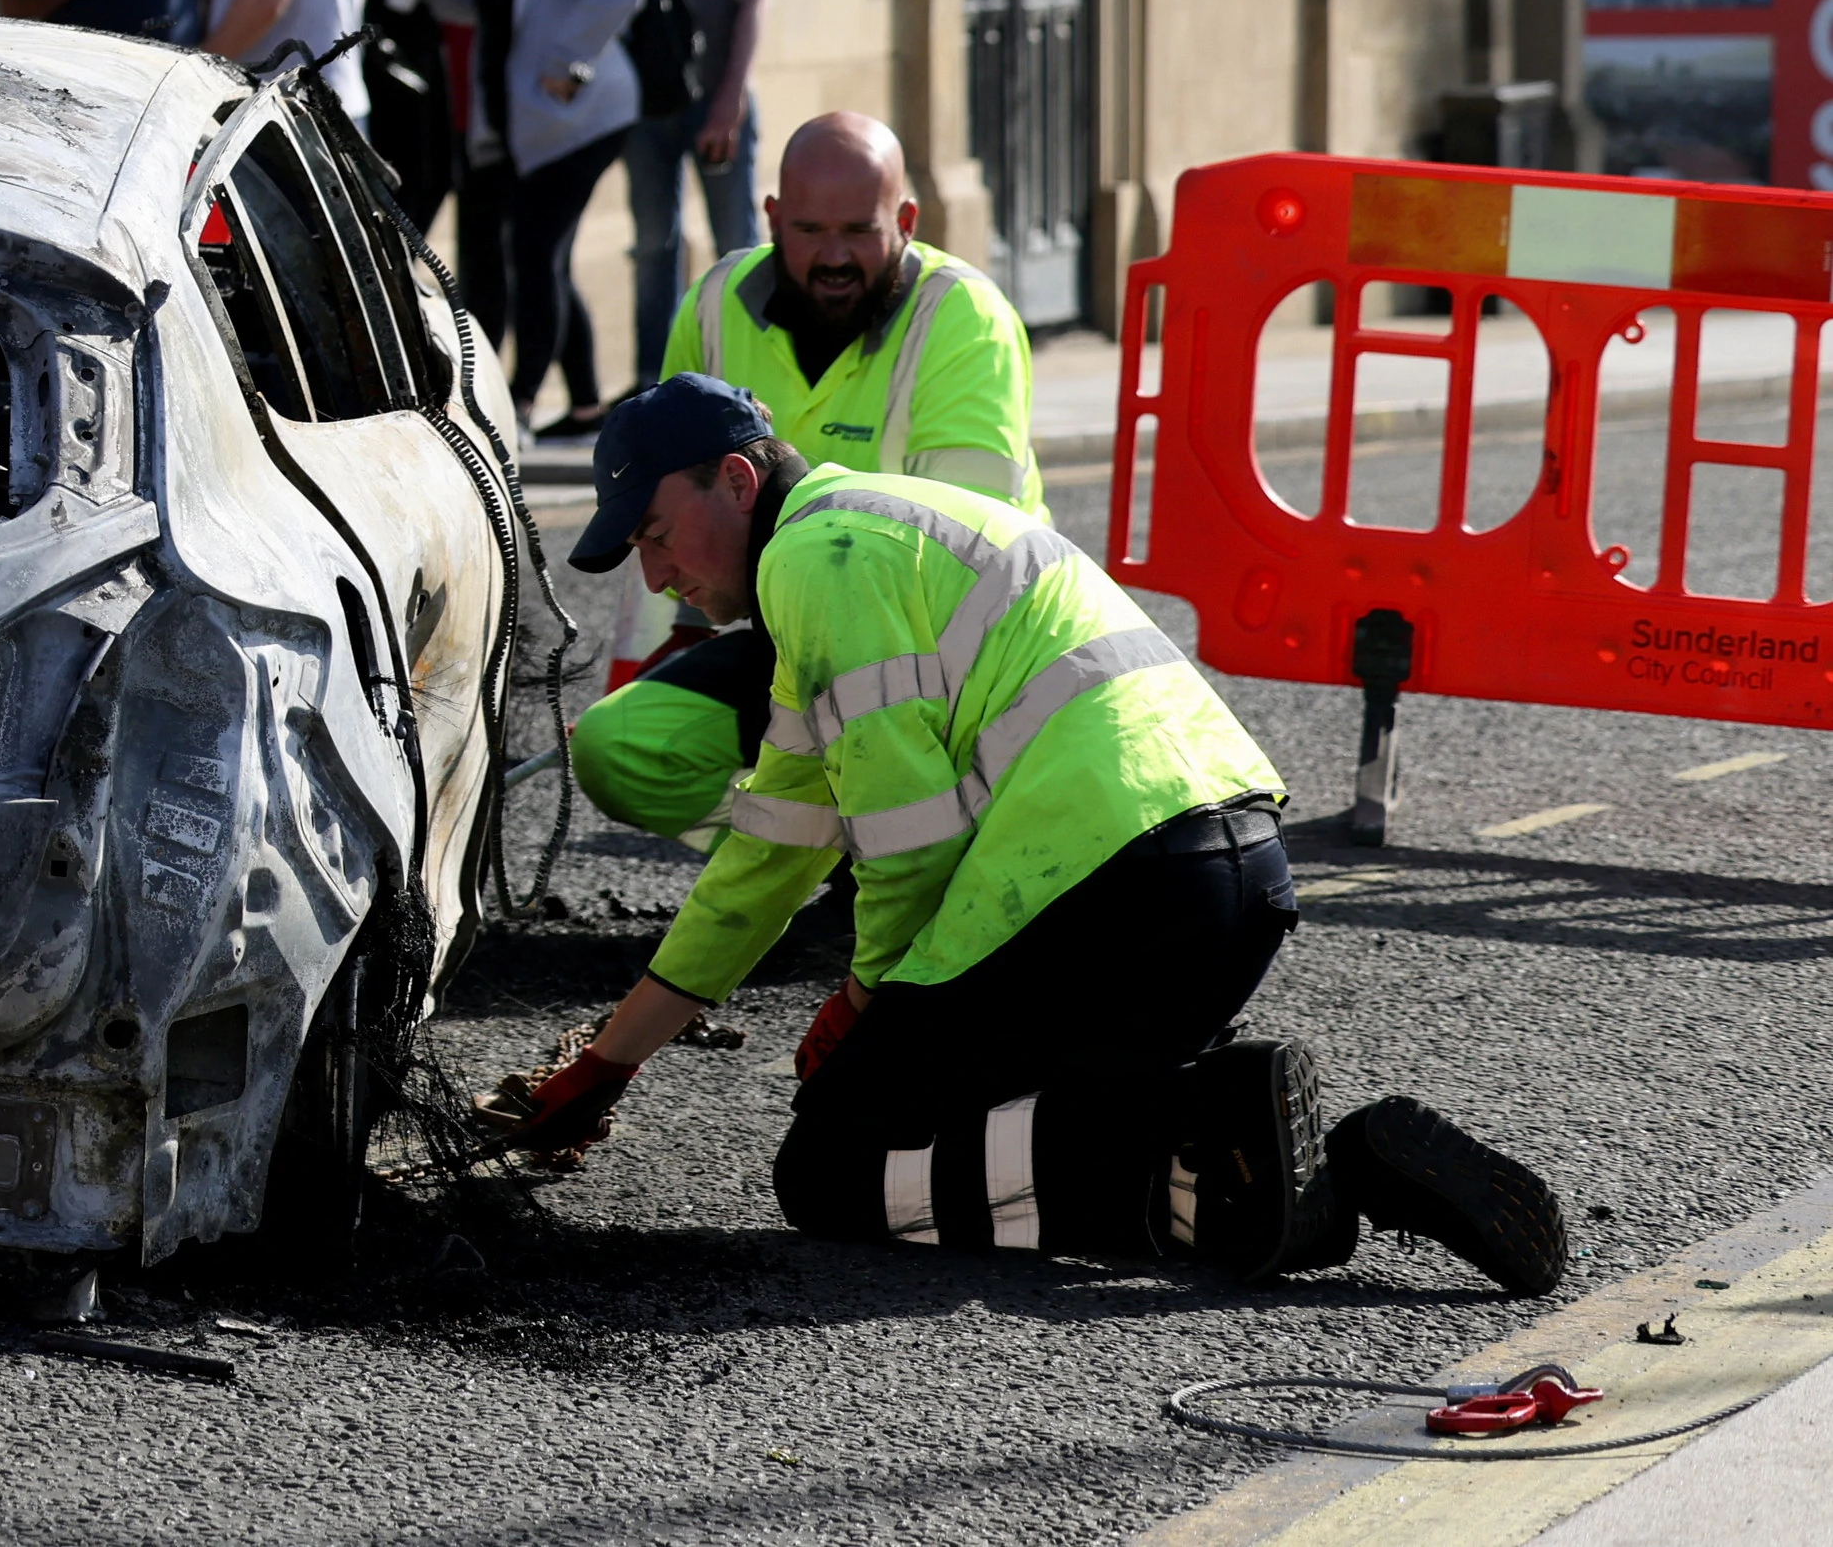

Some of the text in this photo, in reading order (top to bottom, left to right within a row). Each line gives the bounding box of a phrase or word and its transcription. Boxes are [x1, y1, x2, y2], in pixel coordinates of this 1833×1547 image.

[1631, 618, 1820, 663] Sunderland
[1627, 655, 1773, 691] City Council
